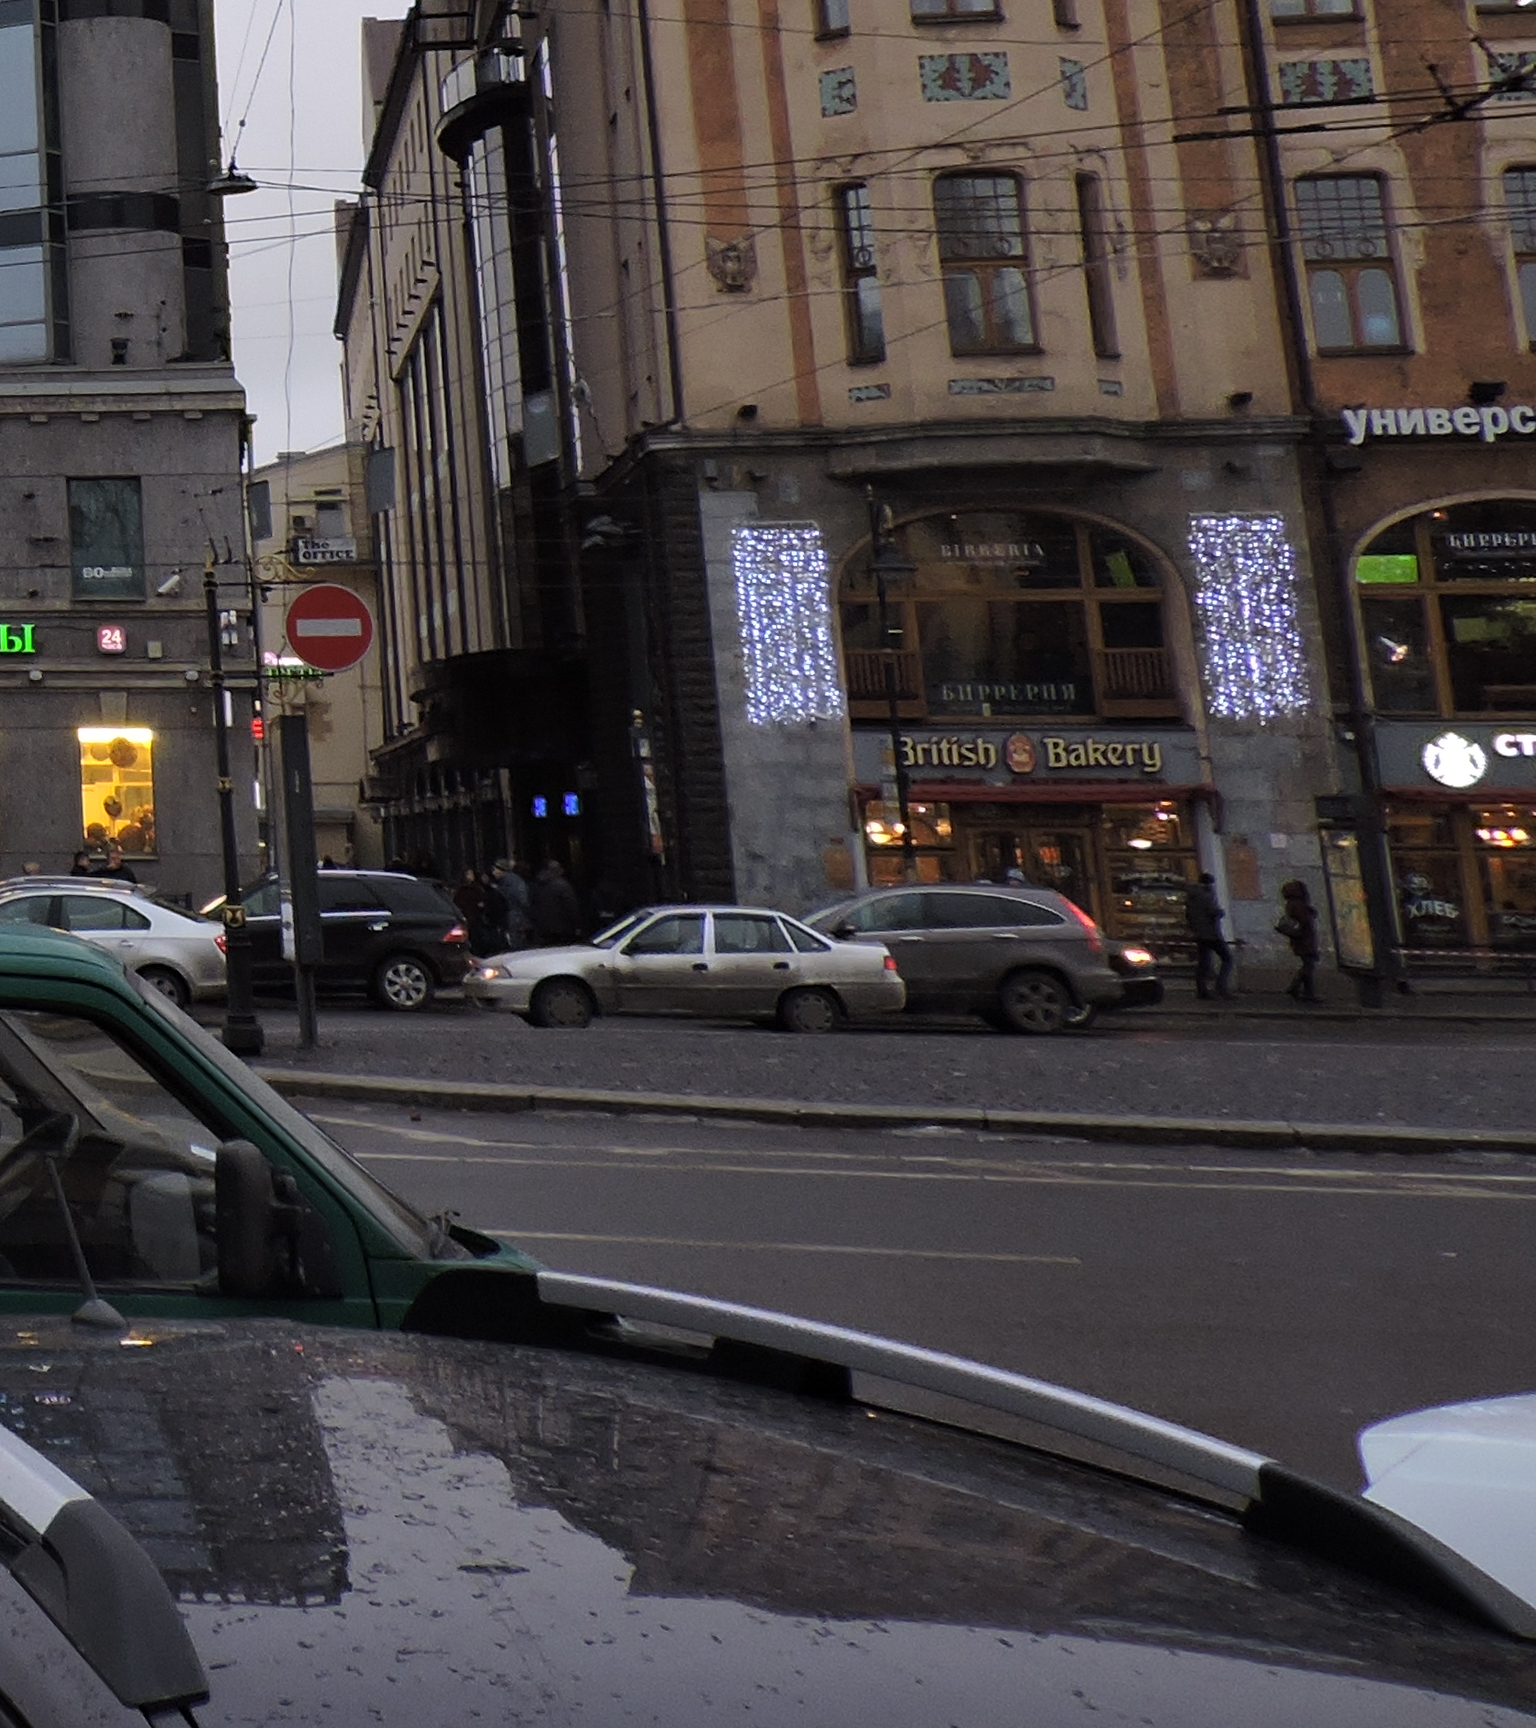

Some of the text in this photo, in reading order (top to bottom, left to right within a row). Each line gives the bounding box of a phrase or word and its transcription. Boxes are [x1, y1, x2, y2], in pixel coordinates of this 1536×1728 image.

[302, 549, 354, 560] OFFICE
[101, 628, 121, 643] 24
[899, 735, 1163, 773] British Bakery
